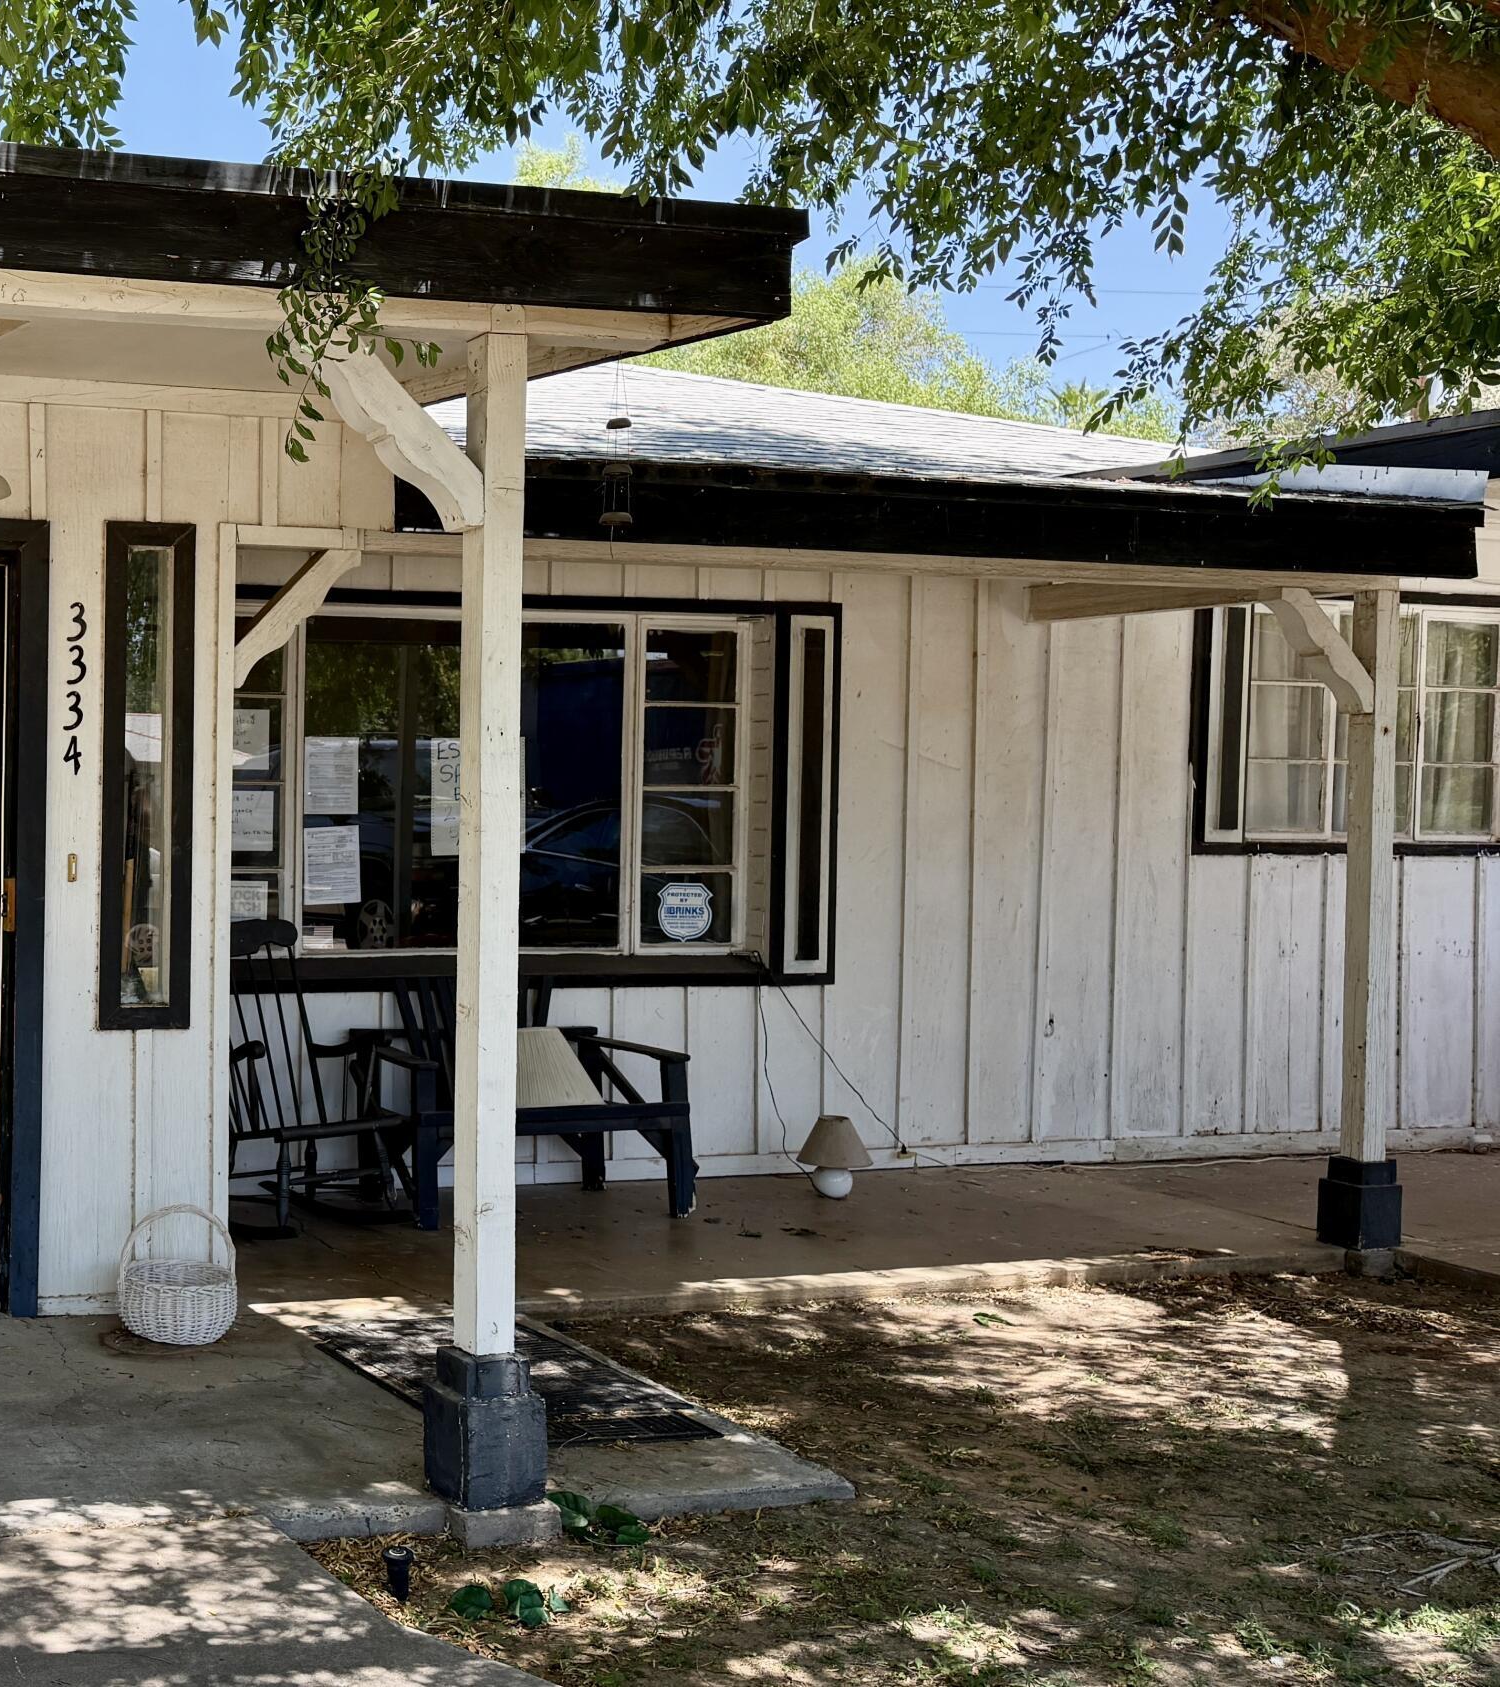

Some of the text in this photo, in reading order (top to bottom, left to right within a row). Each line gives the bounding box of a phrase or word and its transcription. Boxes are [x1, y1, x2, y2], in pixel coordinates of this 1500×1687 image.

[63, 602, 87, 775] 3334
[231, 890, 261, 901] OCK
[664, 906, 705, 915] BRINKS
